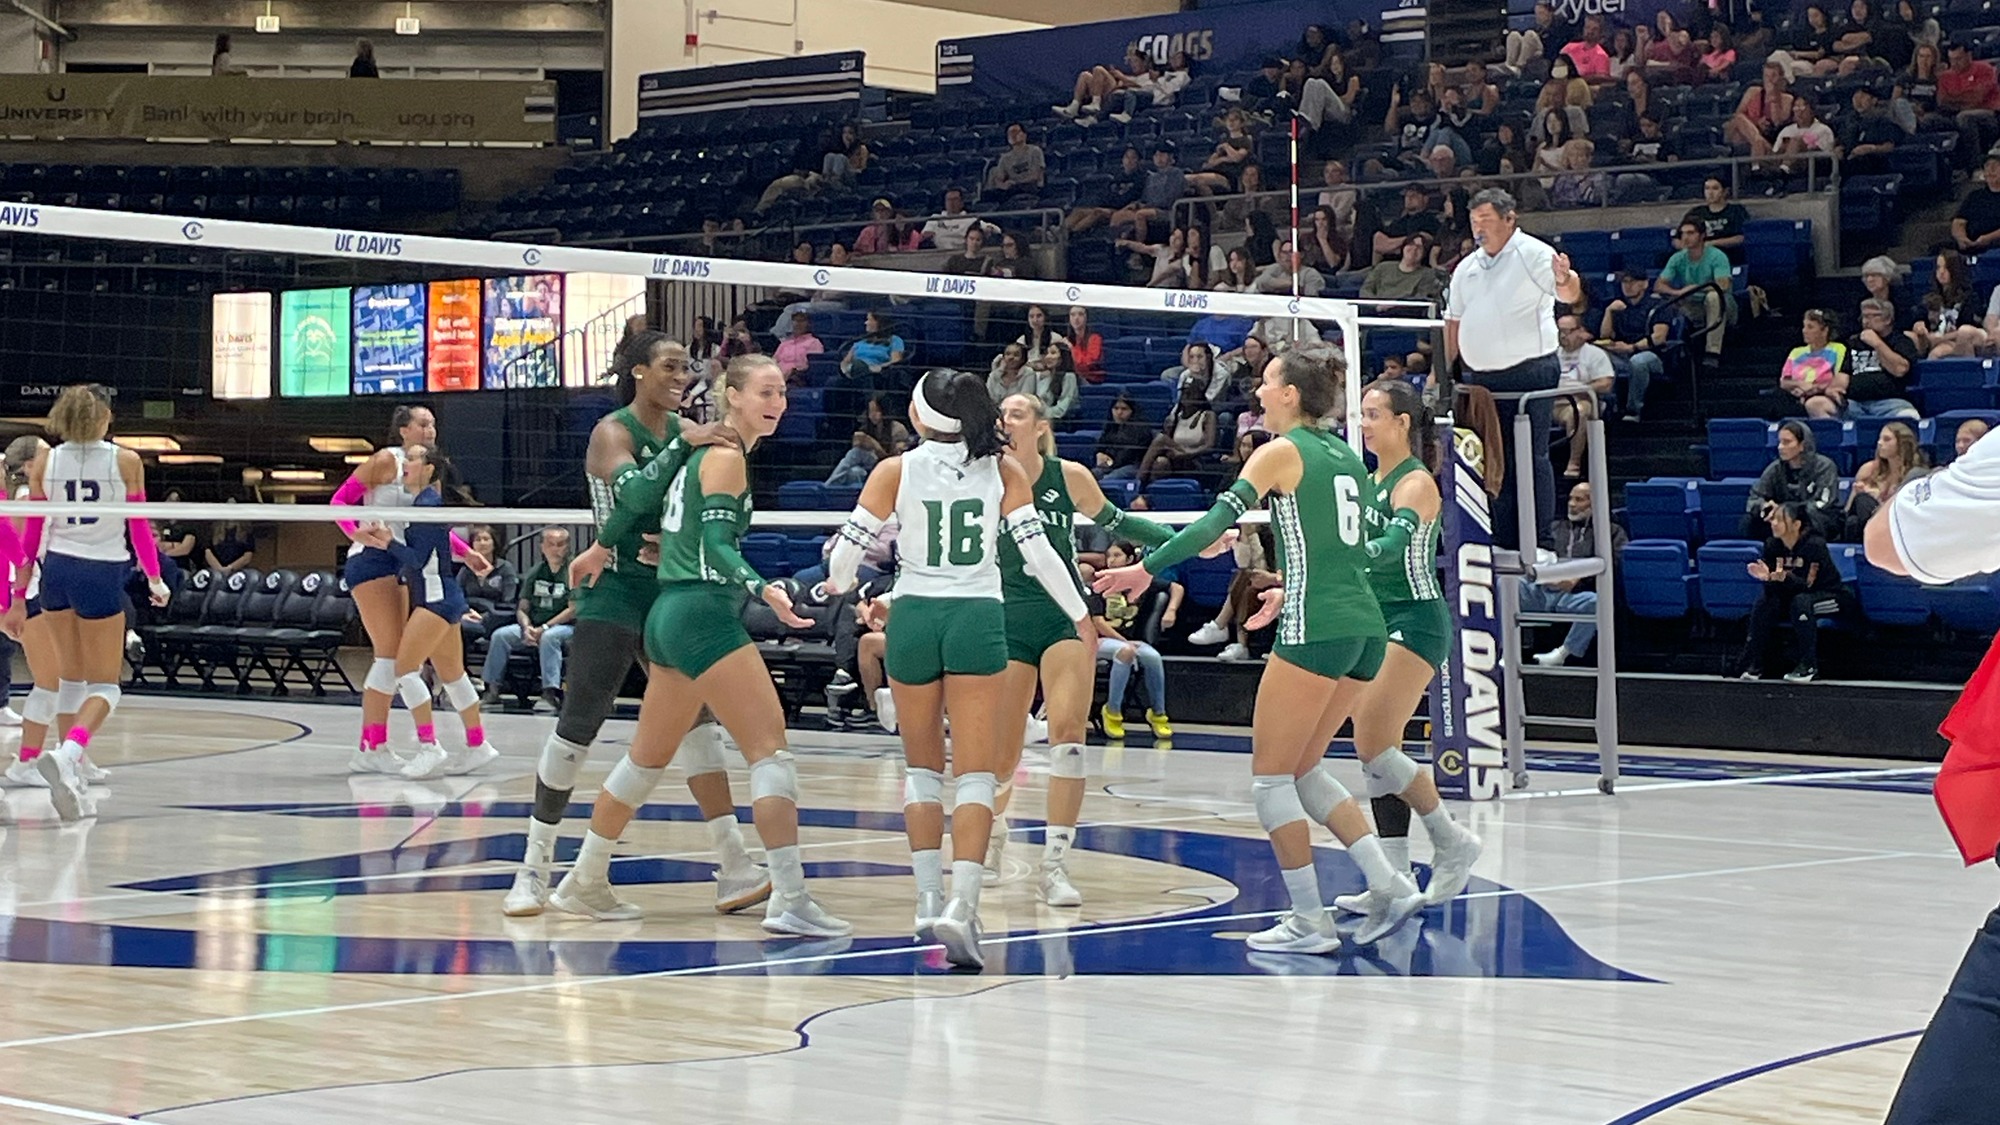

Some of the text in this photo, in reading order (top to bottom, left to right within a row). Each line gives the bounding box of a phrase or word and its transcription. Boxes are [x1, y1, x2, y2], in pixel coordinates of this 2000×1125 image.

[335, 233, 402, 255] UC DAVIS
[652, 258, 711, 277] UC DAVIS
[926, 276, 976, 295] UC DAVIS
[1164, 292, 1208, 309] UC DAVIS
[1333, 474, 1361, 546] 6
[921, 497, 985, 567] 16
[1458, 542, 1504, 800] UC DAVIS
